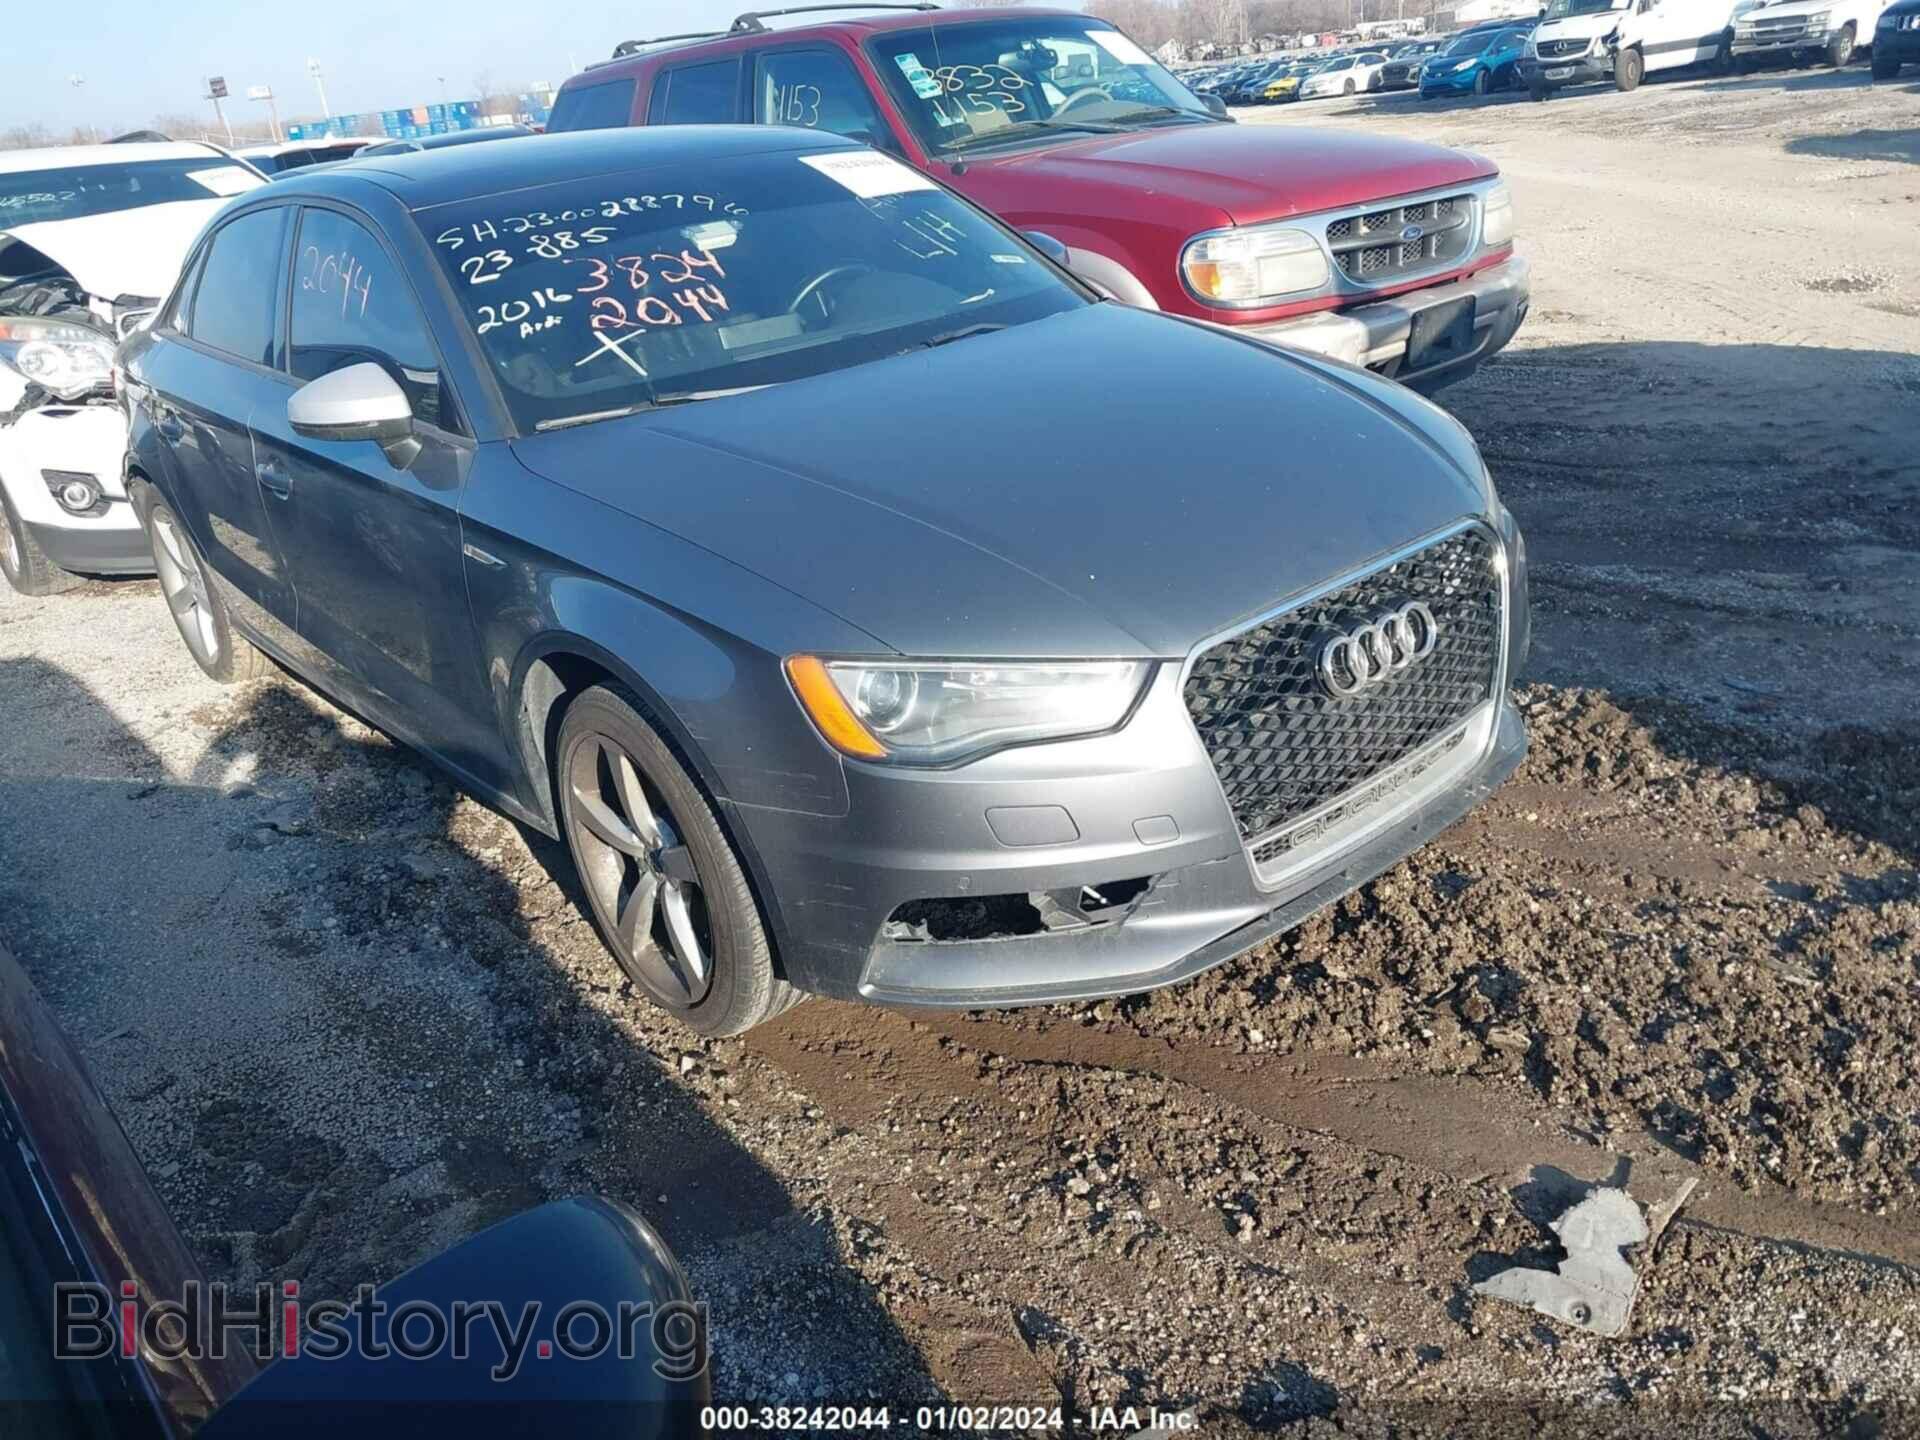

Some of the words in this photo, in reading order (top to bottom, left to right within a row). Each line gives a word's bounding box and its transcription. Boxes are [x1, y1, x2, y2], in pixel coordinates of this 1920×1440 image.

[909, 64, 1034, 92] 3832
[779, 84, 821, 127] 1153
[932, 91, 1026, 119] 1153
[460, 249, 513, 285] 23
[525, 226, 617, 259] 885
[563, 249, 726, 293] 3824
[302, 246, 372, 319] 2044
[477, 287, 574, 335] 2016
[589, 283, 731, 329] 2044
